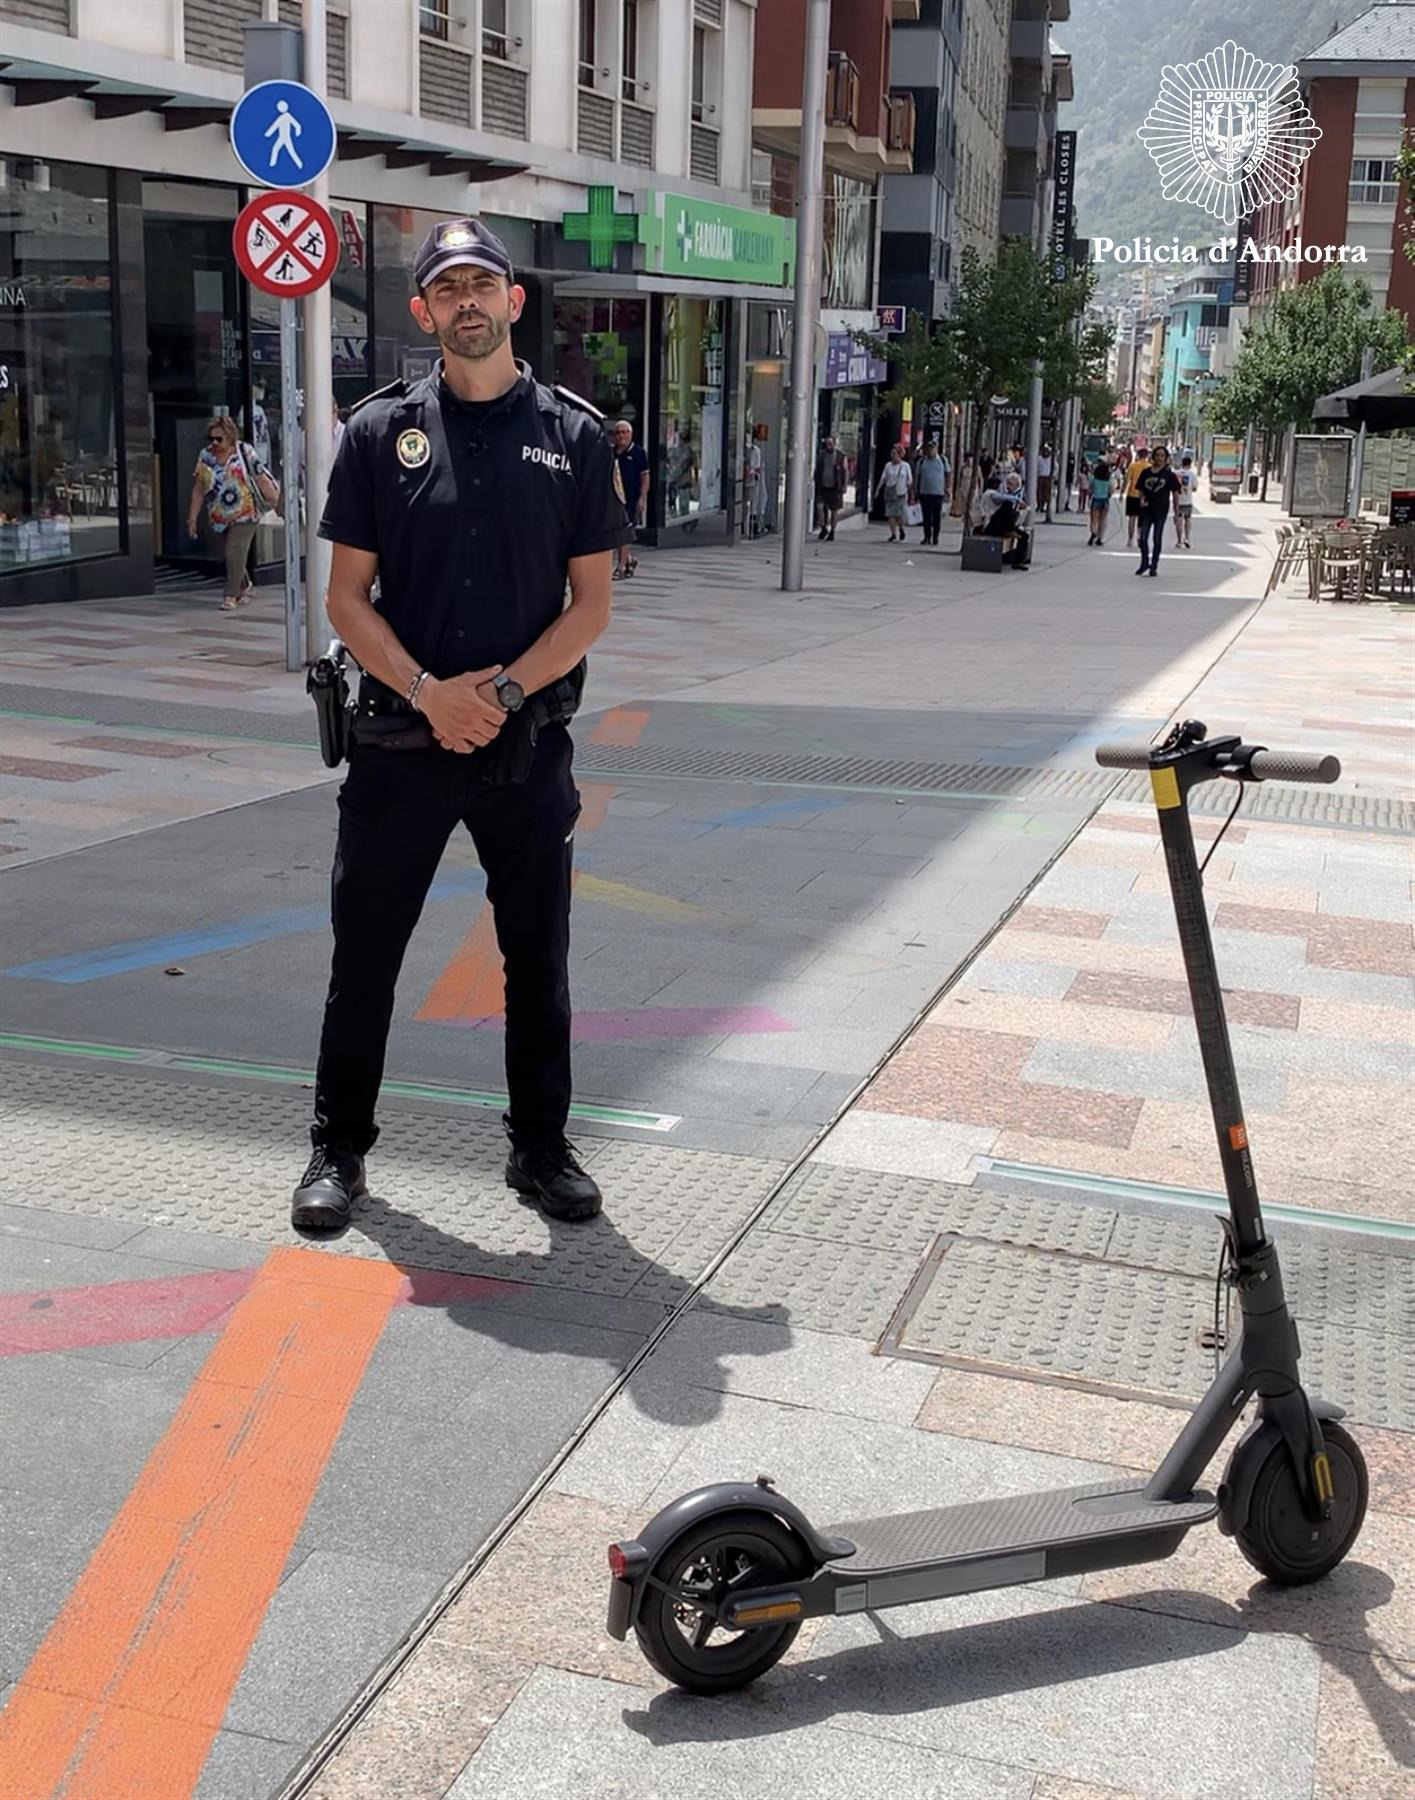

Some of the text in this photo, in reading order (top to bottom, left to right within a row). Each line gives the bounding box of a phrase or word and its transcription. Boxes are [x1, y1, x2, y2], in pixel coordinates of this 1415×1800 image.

[1059, 134, 1071, 185] CLOSES
[1057, 190, 1067, 214] LES
[995, 407, 1029, 417] SOLER
[521, 445, 573, 473] POLICIA
